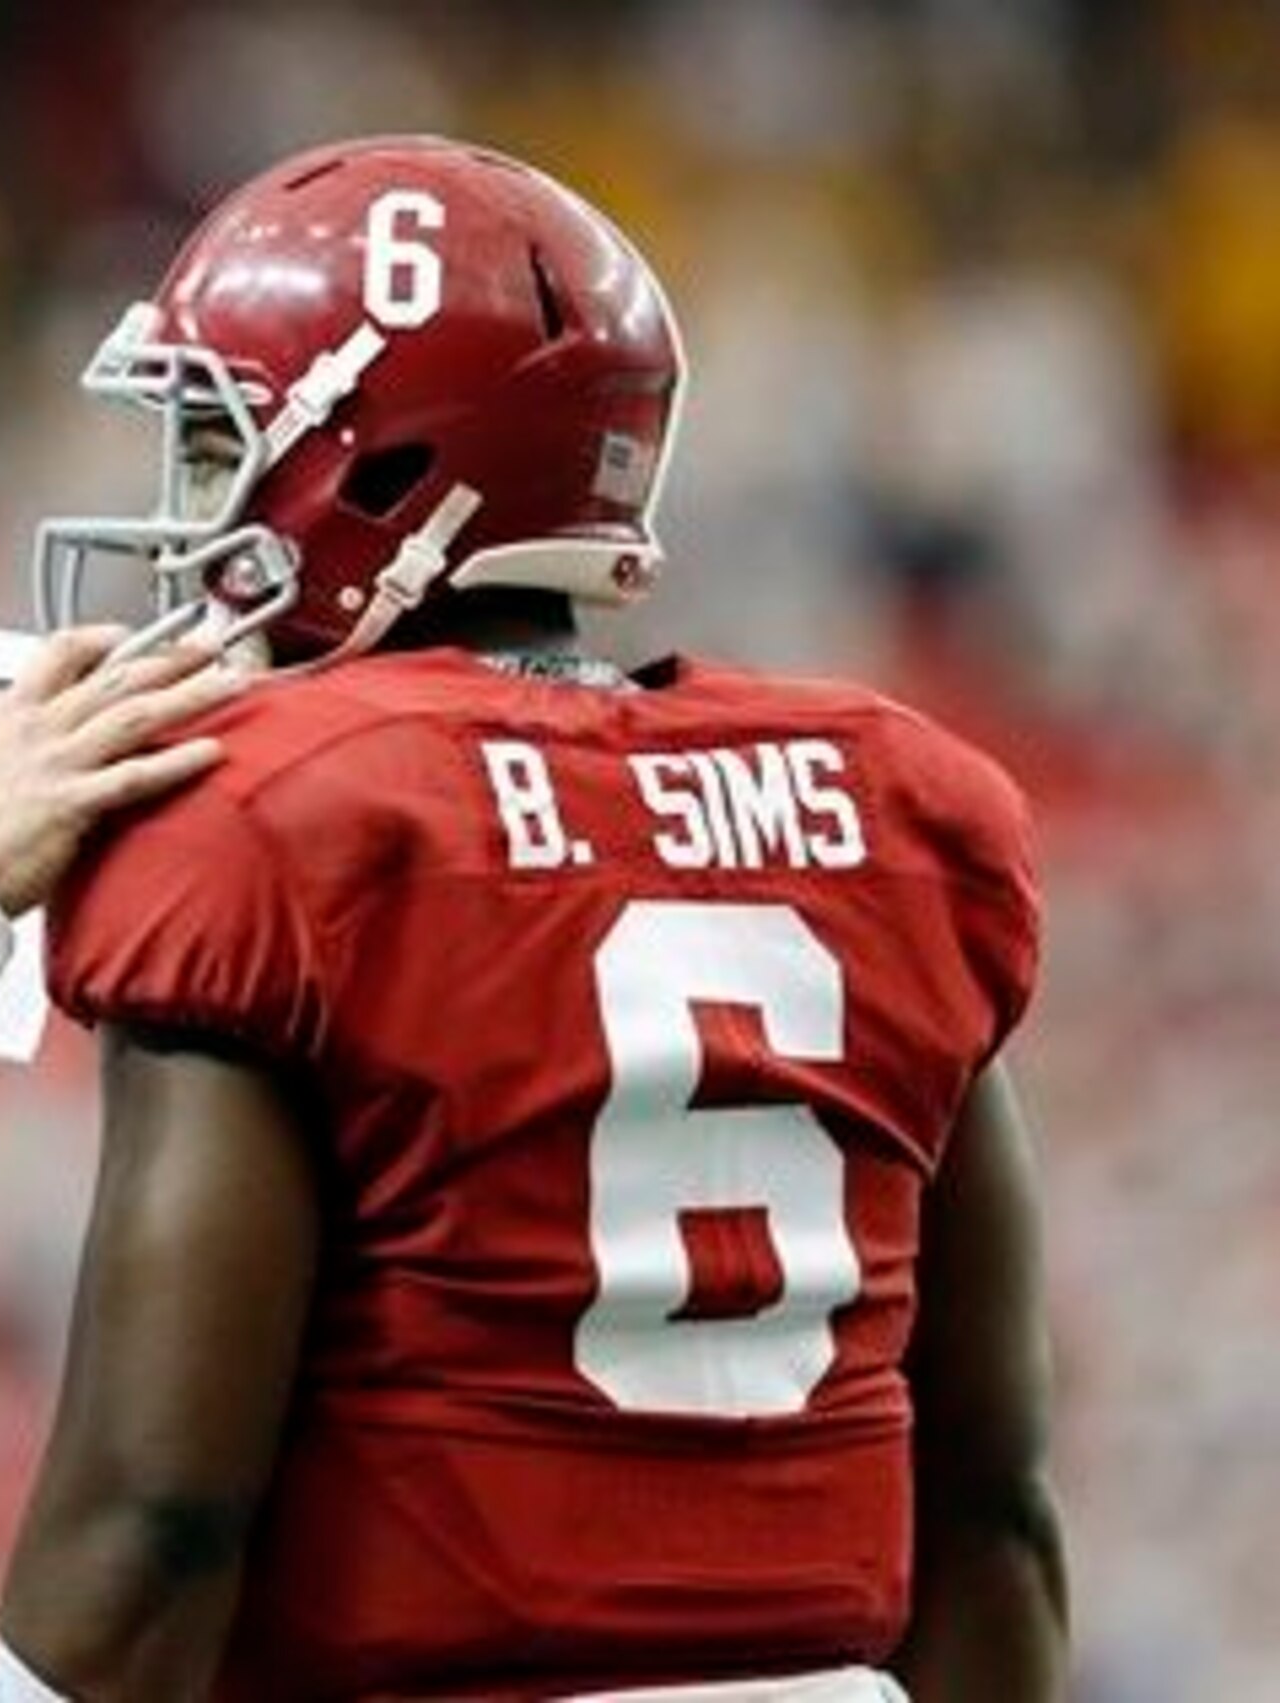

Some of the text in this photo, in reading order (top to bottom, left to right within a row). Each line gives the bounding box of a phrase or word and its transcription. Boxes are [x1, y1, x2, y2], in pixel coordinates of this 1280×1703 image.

[363, 188, 446, 329] 6
[481, 738, 867, 869] B. SIMS
[573, 903, 862, 1419] 6
